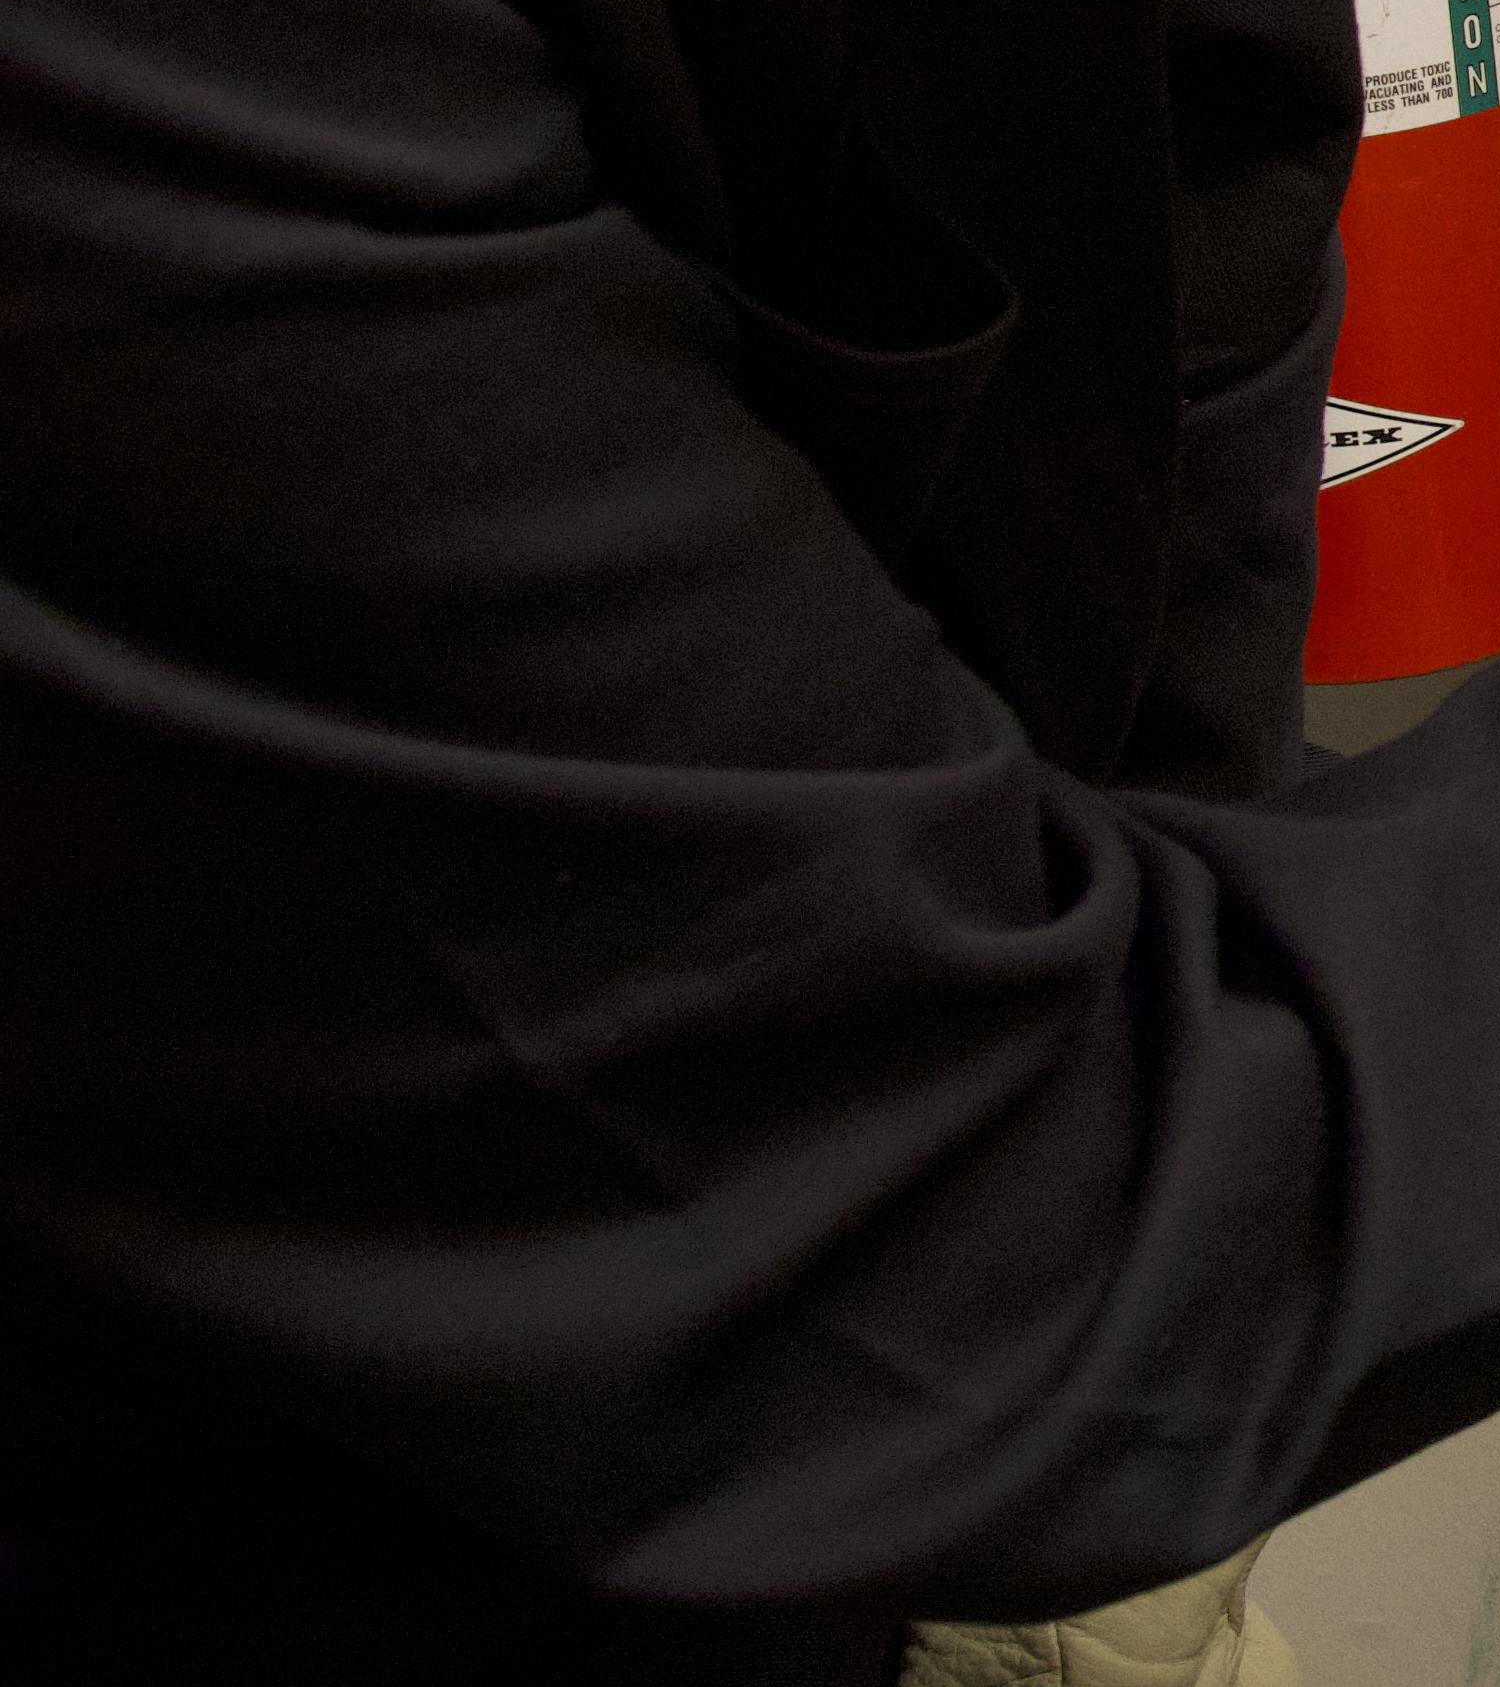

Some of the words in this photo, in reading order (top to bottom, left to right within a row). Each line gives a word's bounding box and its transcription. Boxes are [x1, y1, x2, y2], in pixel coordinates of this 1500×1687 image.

[1365, 67, 1418, 88] PRODUCE
[1420, 61, 1451, 78] TOXIC
[1431, 73, 1452, 89] AND
[1367, 98, 1396, 114] LESS
[1400, 91, 1430, 108] THAN
[1435, 86, 1454, 101] 700
[1326, 426, 1403, 448] EX
